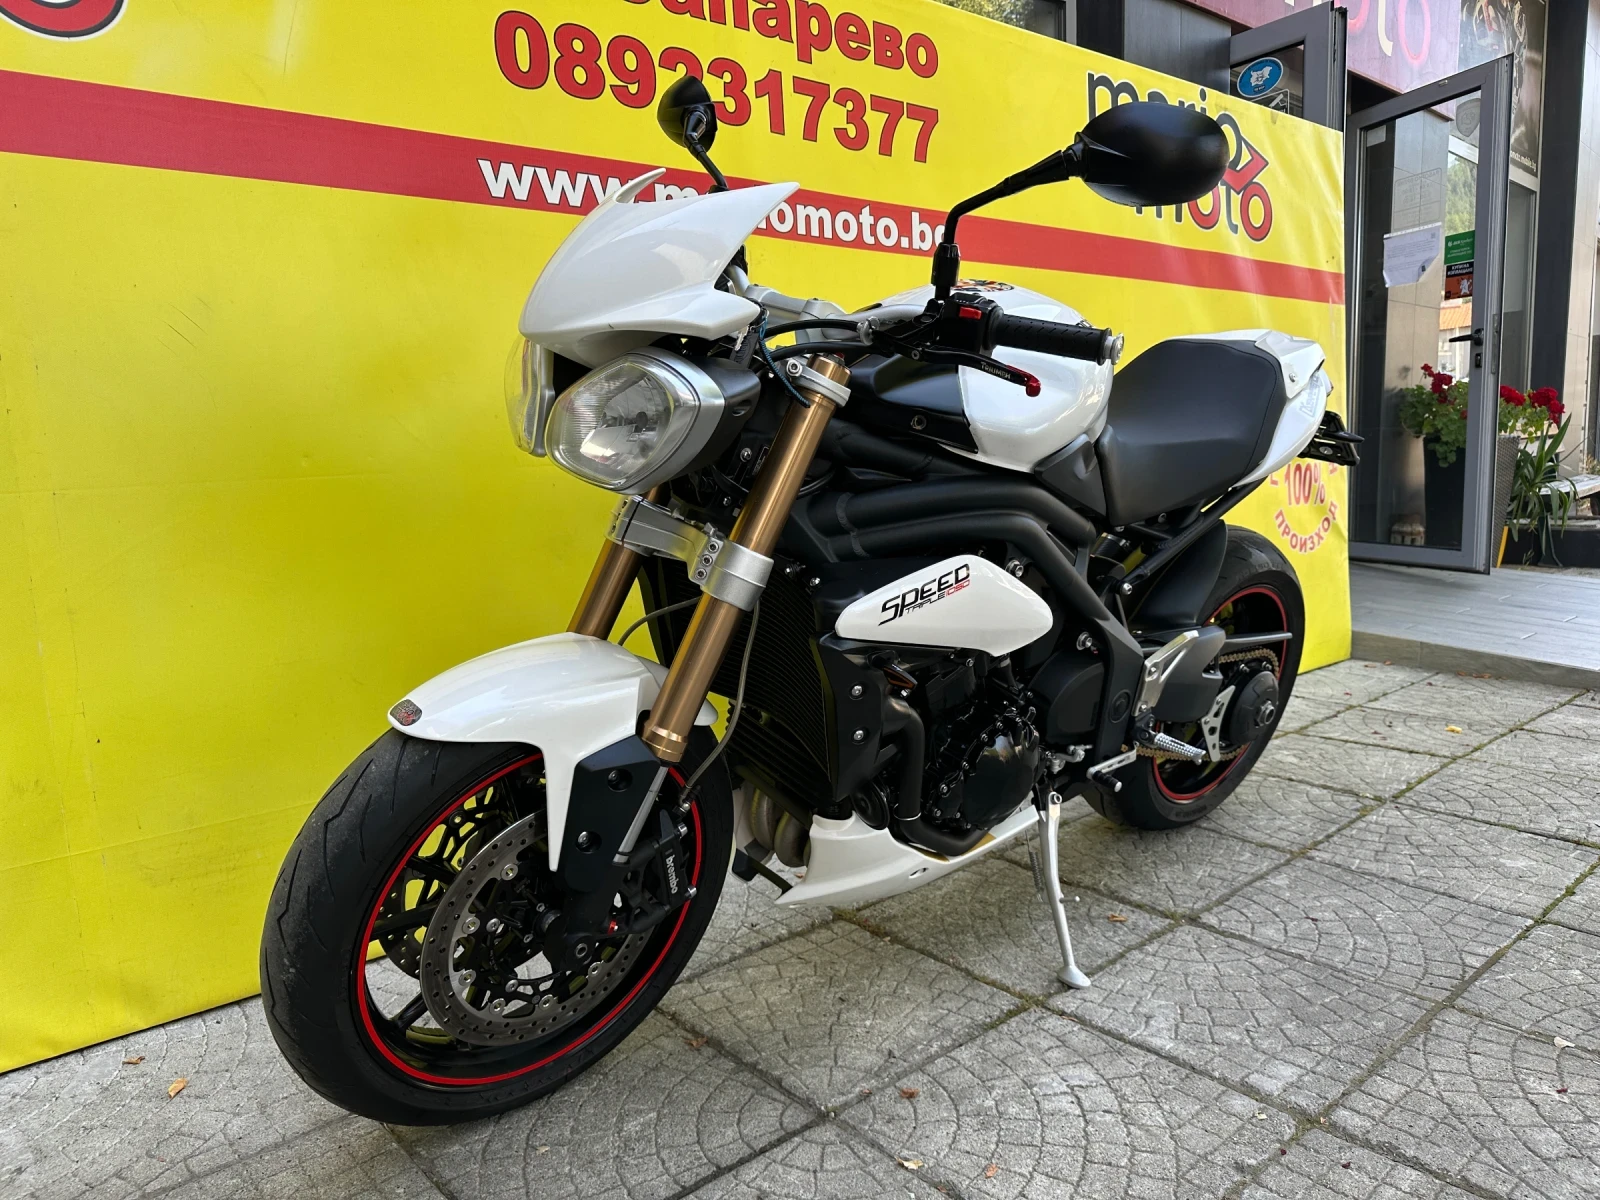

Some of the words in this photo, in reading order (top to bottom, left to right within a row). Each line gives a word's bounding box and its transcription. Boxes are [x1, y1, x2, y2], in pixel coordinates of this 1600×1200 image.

[624, 0, 938, 78] парево
[477, 158, 946, 251] wwwmomoto.b
[1135, 180, 1273, 242] oto
[981, 362, 1011, 379] TRIUMPH
[1285, 463, 1325, 505] 100%
[1275, 501, 1338, 552] ПРОИЗХОД
[878, 563, 971, 626] SPEED
[665, 854, 679, 894] brembo
